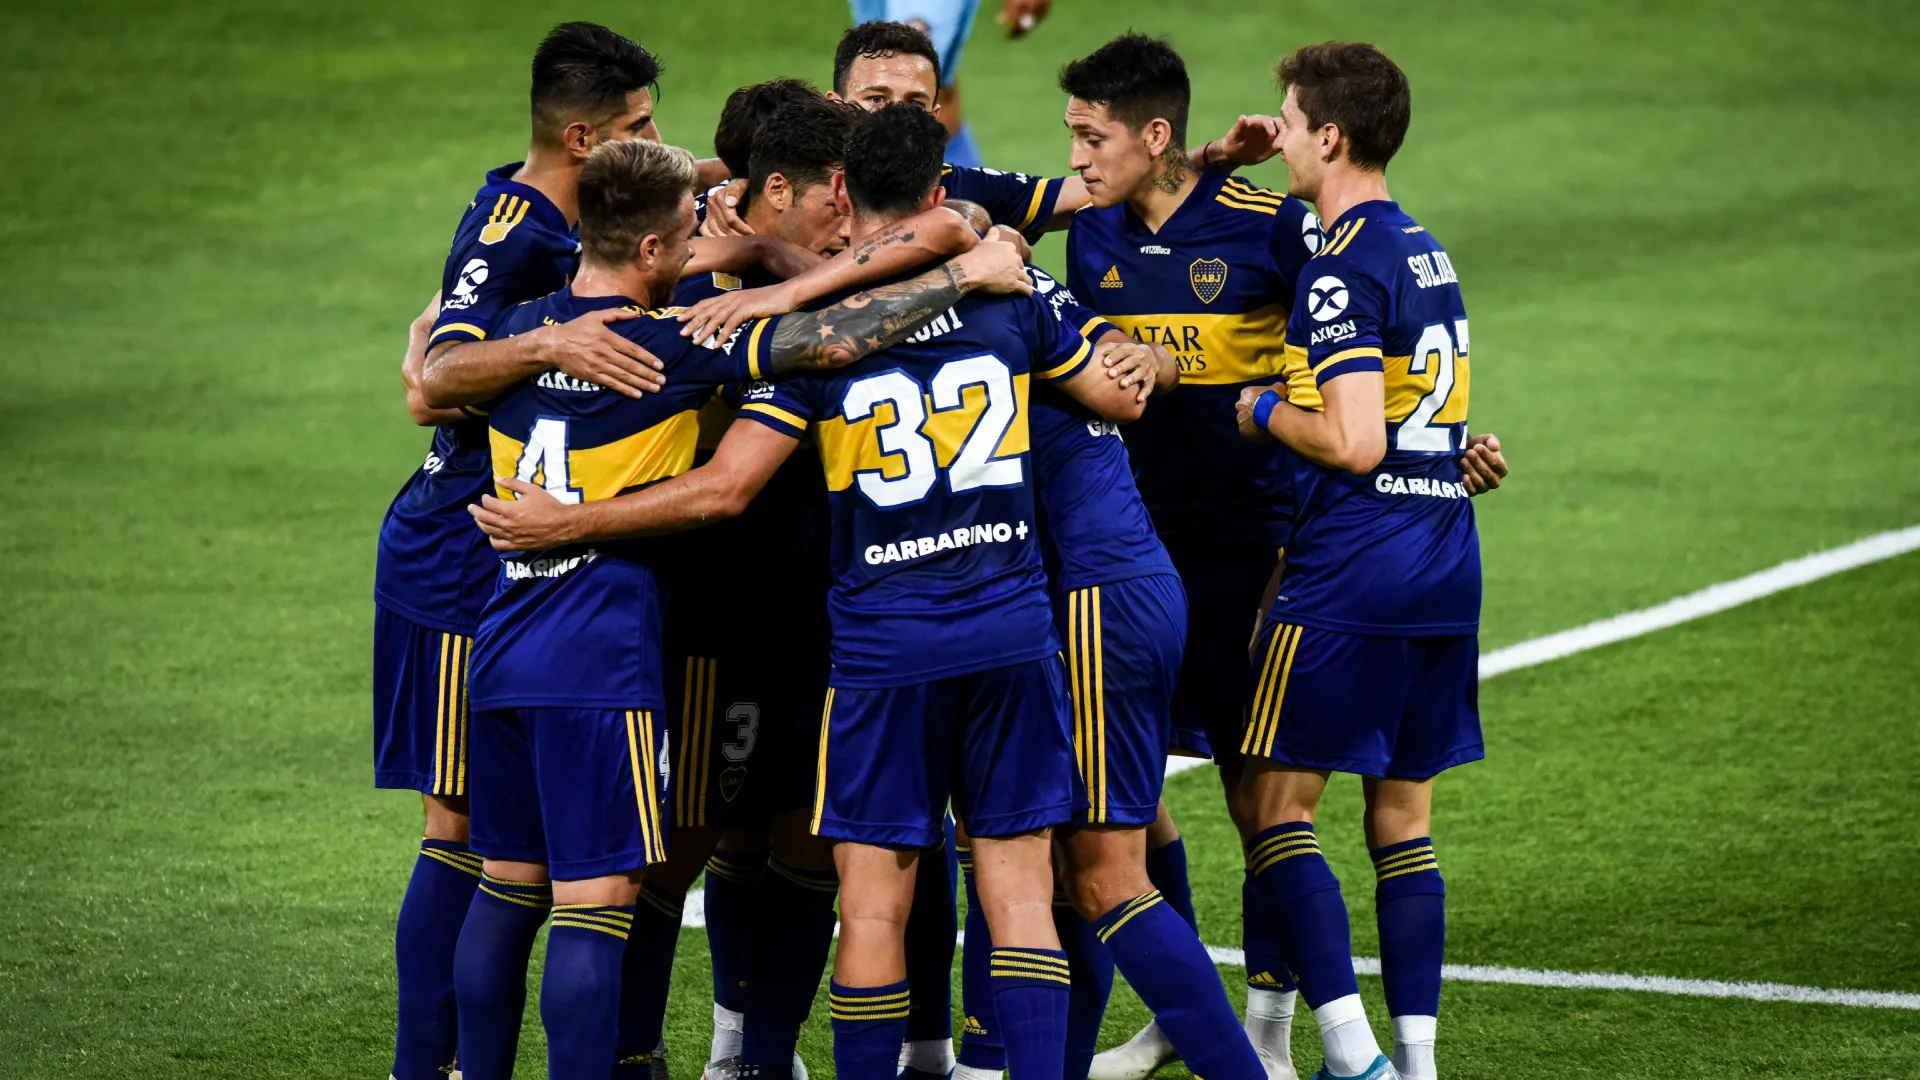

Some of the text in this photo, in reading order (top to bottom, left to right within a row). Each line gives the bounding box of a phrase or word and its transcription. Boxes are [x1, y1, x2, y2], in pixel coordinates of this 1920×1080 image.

[1100, 280, 1124, 288] adidas
[1194, 273, 1222, 283] CABJ
[1311, 319, 1357, 346] AXION
[842, 352, 1025, 509] 32
[515, 415, 583, 505] 4
[722, 702, 760, 762] 3
